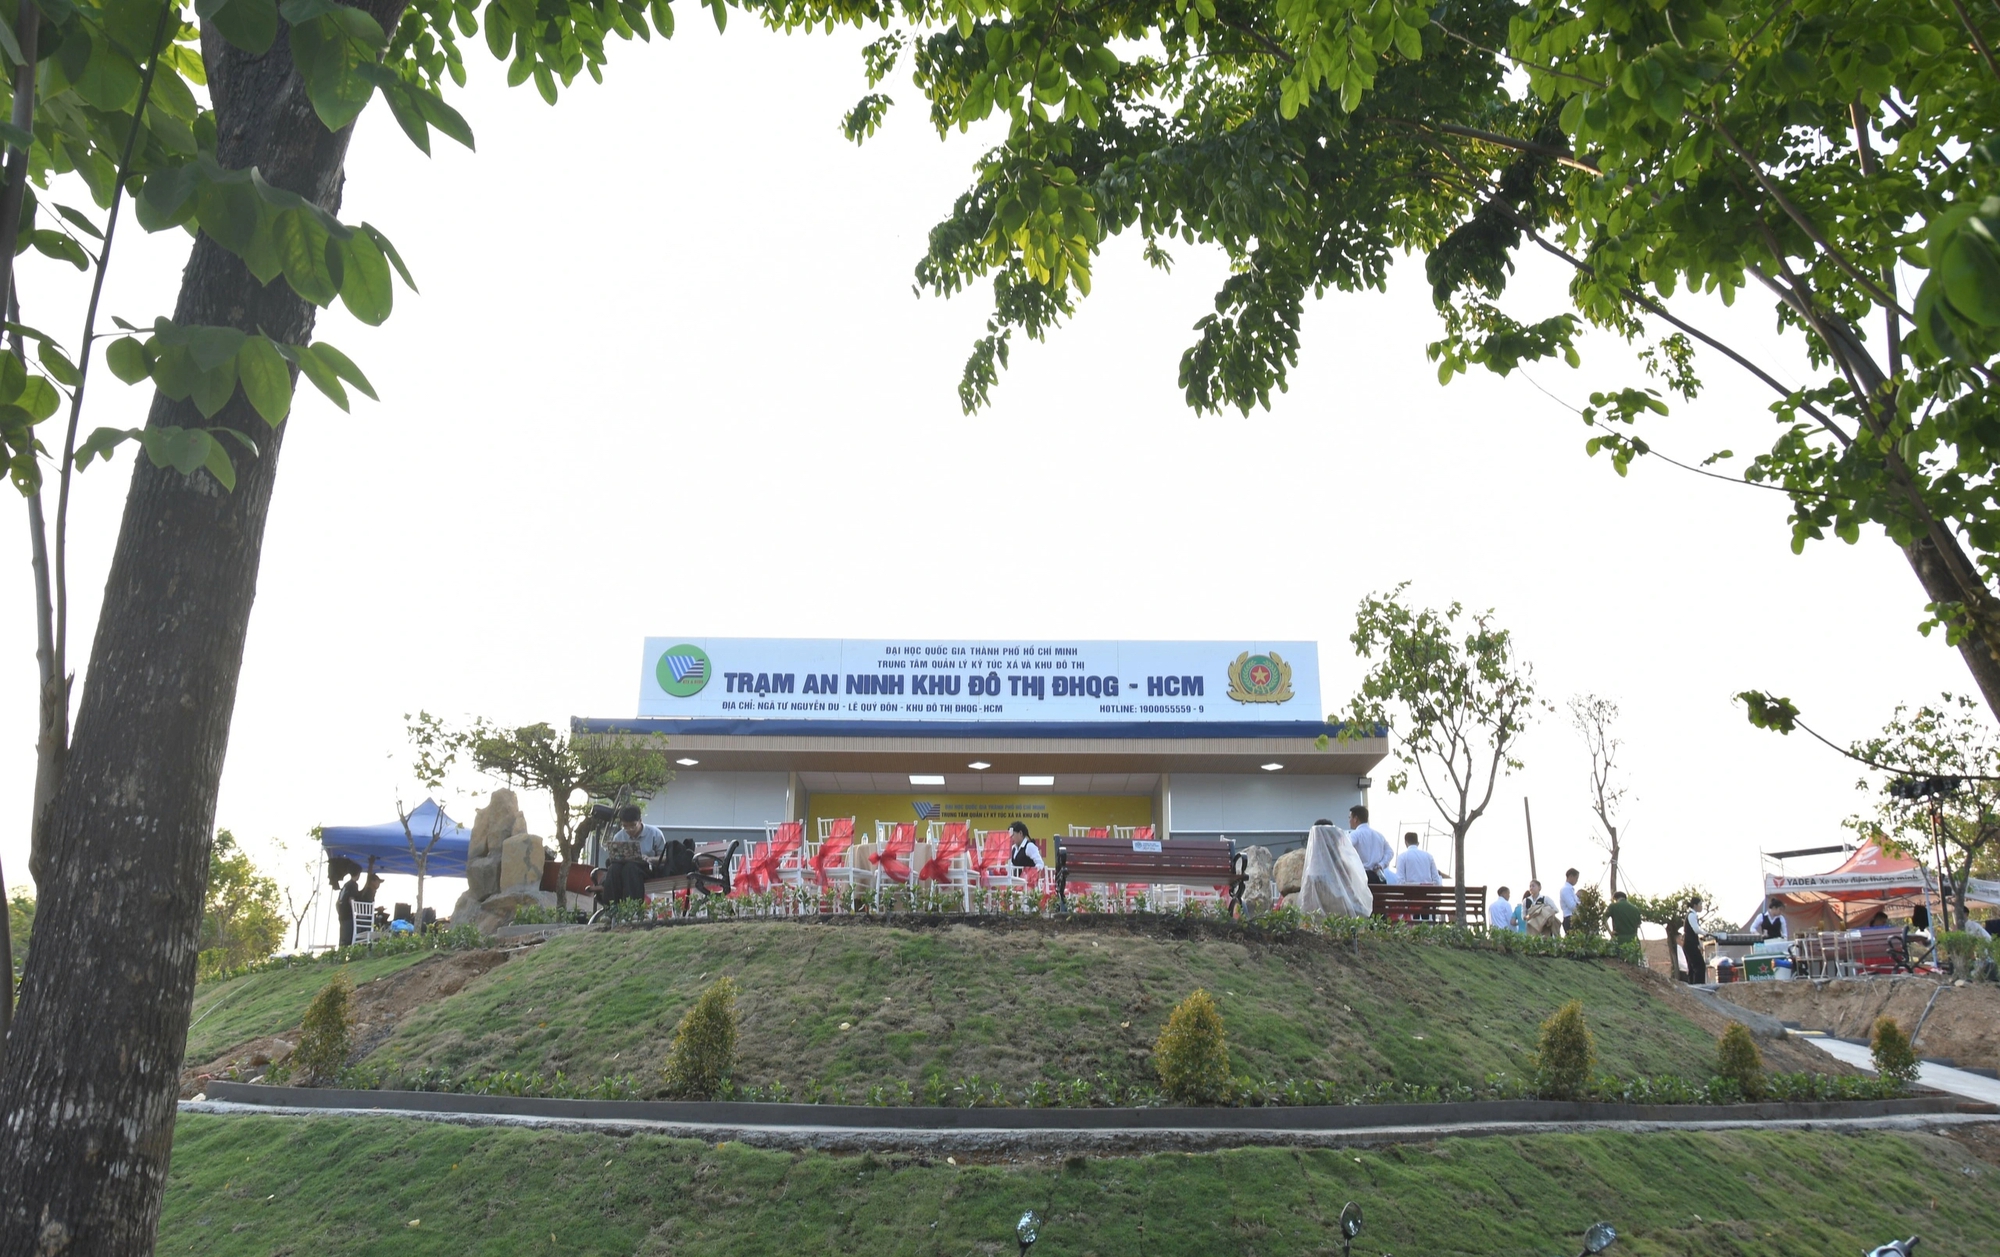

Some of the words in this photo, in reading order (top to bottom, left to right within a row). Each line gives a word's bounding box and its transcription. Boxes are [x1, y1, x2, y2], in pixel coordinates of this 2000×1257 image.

[886, 647, 901, 656] ĐẠI
[904, 647, 921, 656] HỌC
[925, 645, 947, 656] QUỐC
[952, 647, 966, 655] GIA
[970, 646, 999, 656] THÀNH
[1003, 645, 1020, 656] PHỐ
[1038, 646, 1052, 656] CHÍ
[1055, 647, 1078, 656] MINH
[878, 660, 906, 669] TRUNG
[910, 659, 928, 669] TÂM
[932, 658, 955, 669] QUẢN
[959, 659, 968, 669] LÝ
[987, 659, 1002, 669] TÚC
[1021, 659, 1031, 670] VÀ
[1035, 661, 1052, 670] KHU
[1056, 659, 1067, 670] ĐÔ
[1071, 661, 1085, 671] THỊ
[724, 673, 794, 698] TRẠM
[802, 673, 839, 694] AN
[846, 674, 904, 695] NINH
[912, 675, 960, 695] KHU
[968, 671, 1001, 696] ĐÔ
[1008, 676, 1045, 700] THỊ
[1052, 676, 1119, 698] ĐHQG
[1147, 676, 1204, 696] HCM
[722, 701, 737, 711] ĐỊA
[739, 699, 755, 710] CHỈ:
[758, 700, 775, 710] NGÃ
[777, 701, 788, 711] TƯ
[828, 702, 840, 711] DU
[848, 701, 858, 711] LÊ
[861, 701, 877, 712] QUÝ
[880, 702, 898, 712] ĐÔN
[906, 703, 923, 712] KHU
[926, 702, 938, 712] ĐÔ
[940, 704, 952, 714] THỊ
[955, 704, 977, 713] ĐHQG
[983, 704, 1003, 713] HCM
[1100, 704, 1137, 713] HOTLINE:
[1140, 704, 1191, 713] 1900055559
[1787, 877, 1817, 886] YADEA
[1819, 877, 1830, 885] Xe
